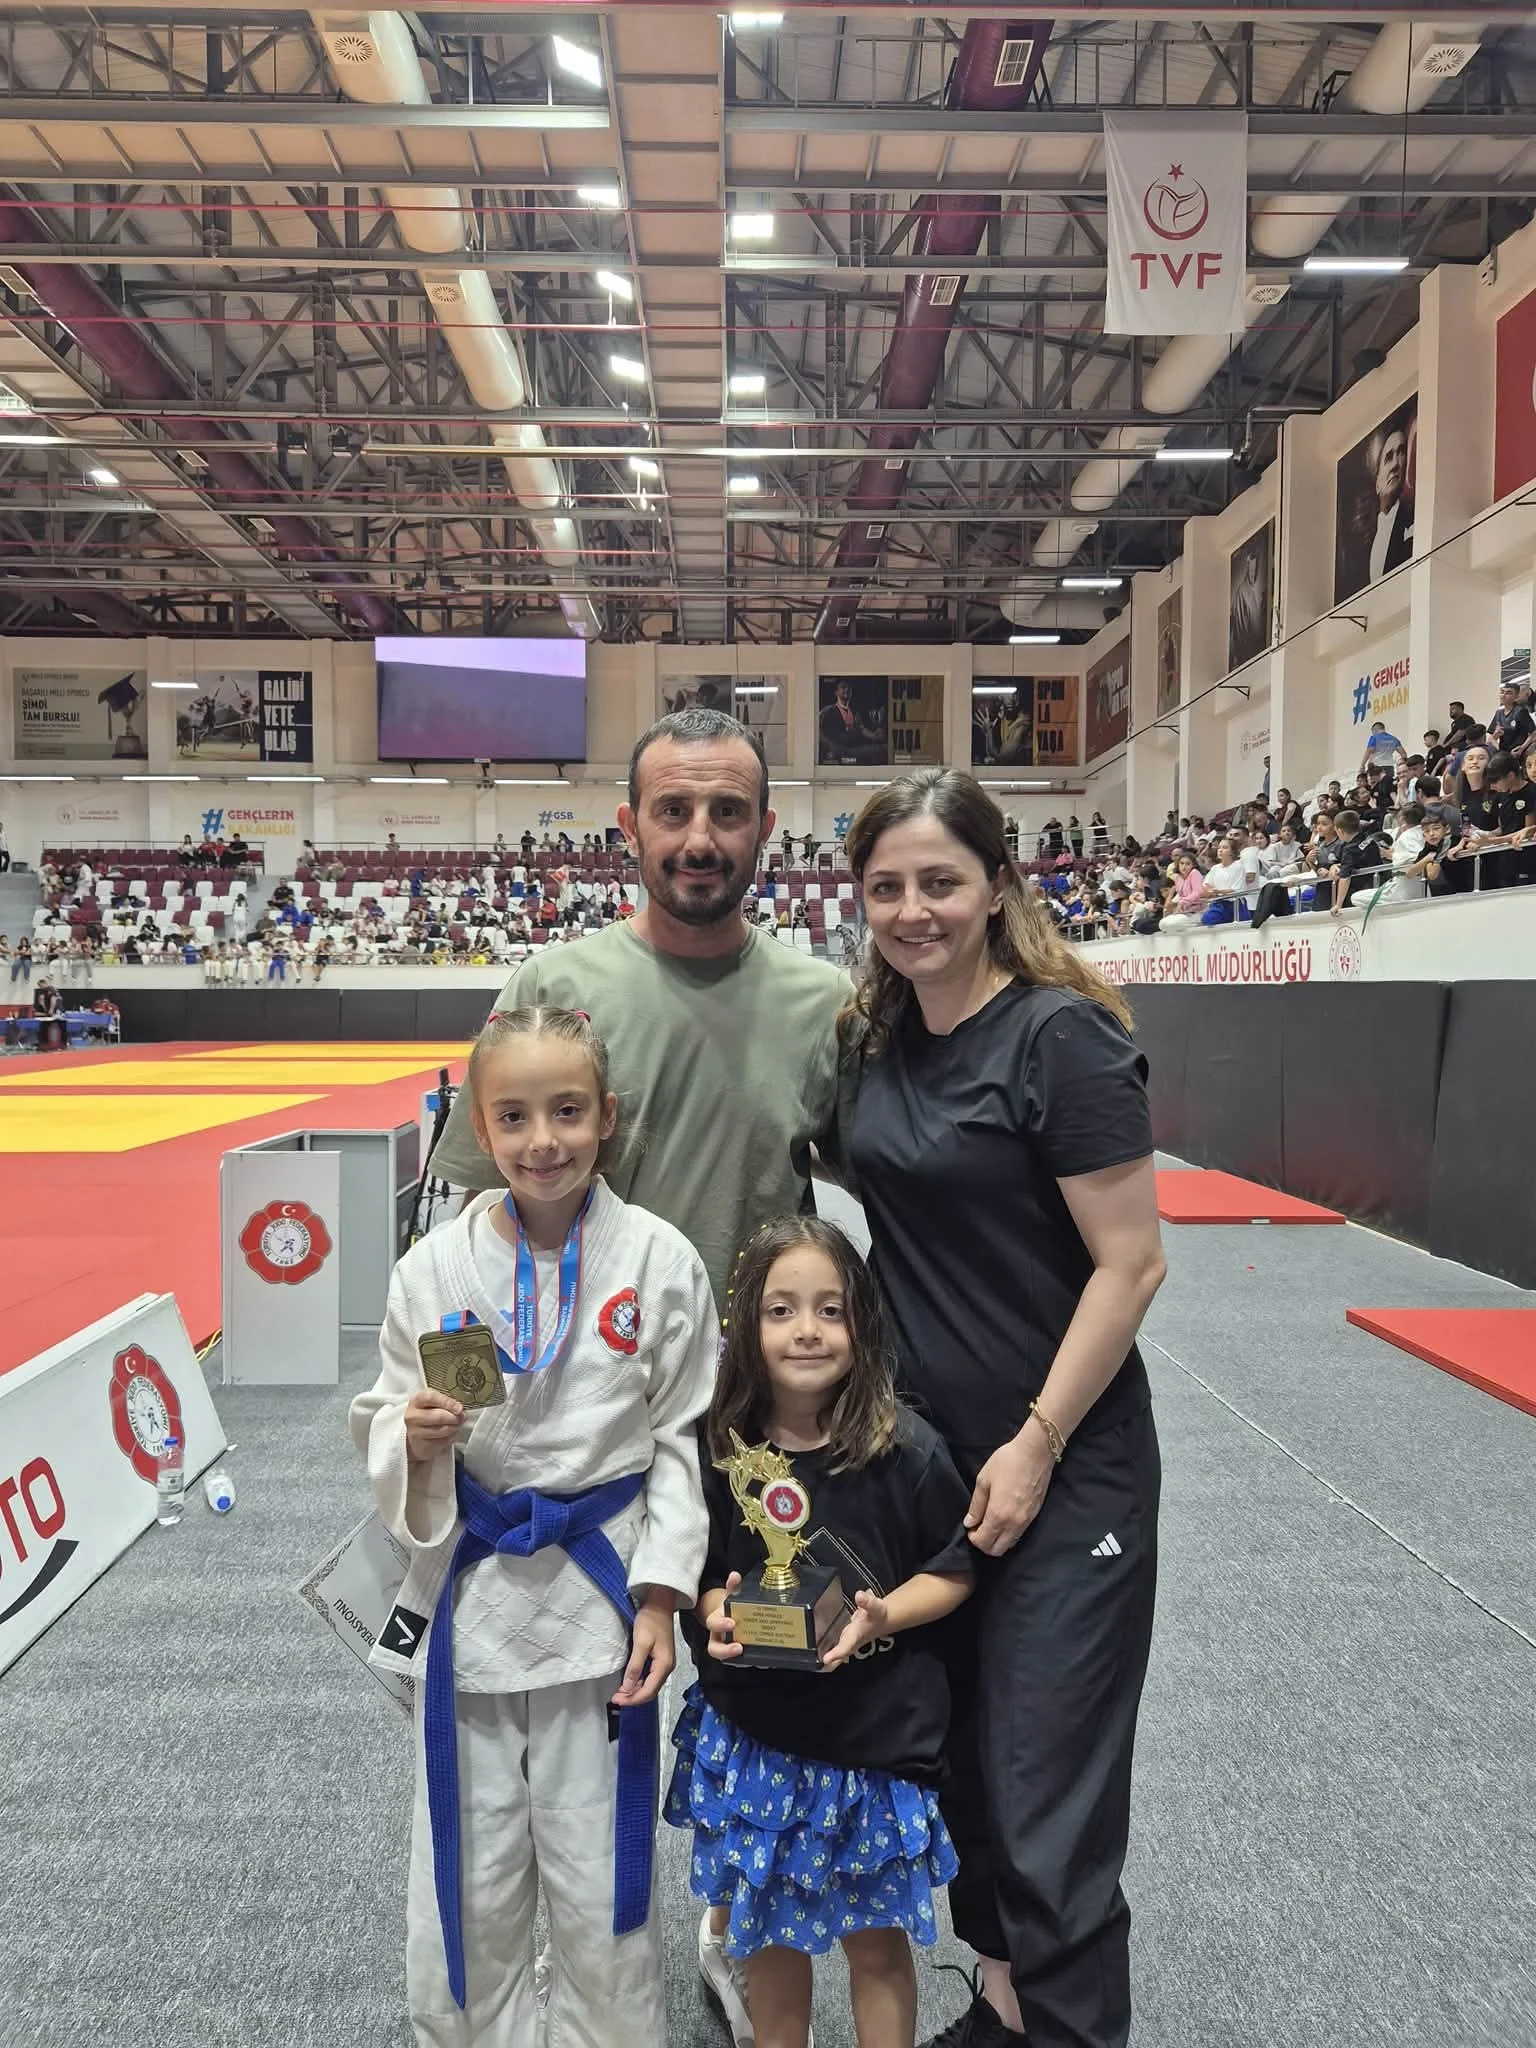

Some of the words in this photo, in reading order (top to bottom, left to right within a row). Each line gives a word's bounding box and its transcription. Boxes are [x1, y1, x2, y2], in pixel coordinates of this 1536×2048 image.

[1130, 252, 1223, 290] TVF
[23, 711, 41, 721] TAM
[264, 704, 296, 727] YETE
[1142, 956, 1156, 982] VE
[1158, 953, 1189, 983] SPOR
[1192, 947, 1203, 982] İL
[1206, 939, 1312, 983] MÜDÜRLÜĞÜ
[0, 1456, 66, 1563] TO
[333, 1598, 377, 1648] DERASYONU
